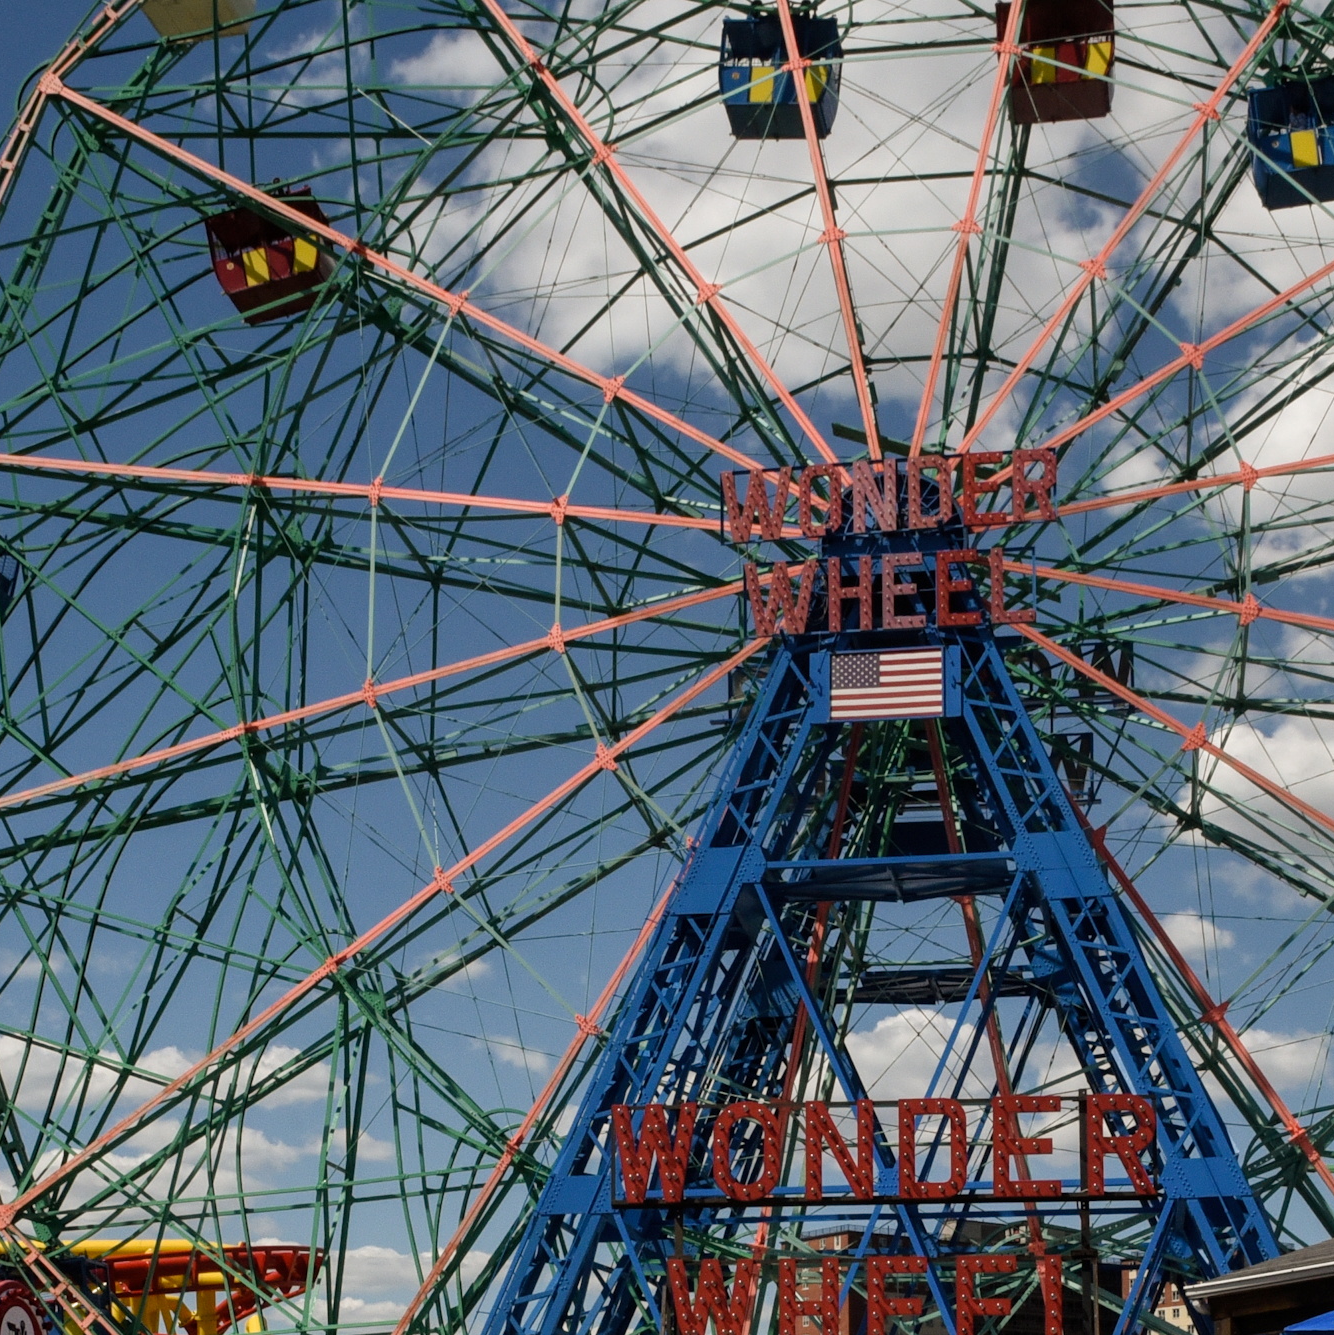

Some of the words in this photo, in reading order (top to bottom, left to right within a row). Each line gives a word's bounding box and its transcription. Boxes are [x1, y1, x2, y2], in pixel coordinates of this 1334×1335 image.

[721, 449, 1057, 542] WONDER
[744, 547, 1036, 637] WHEEL
[611, 1094, 1158, 1203] WONDER
